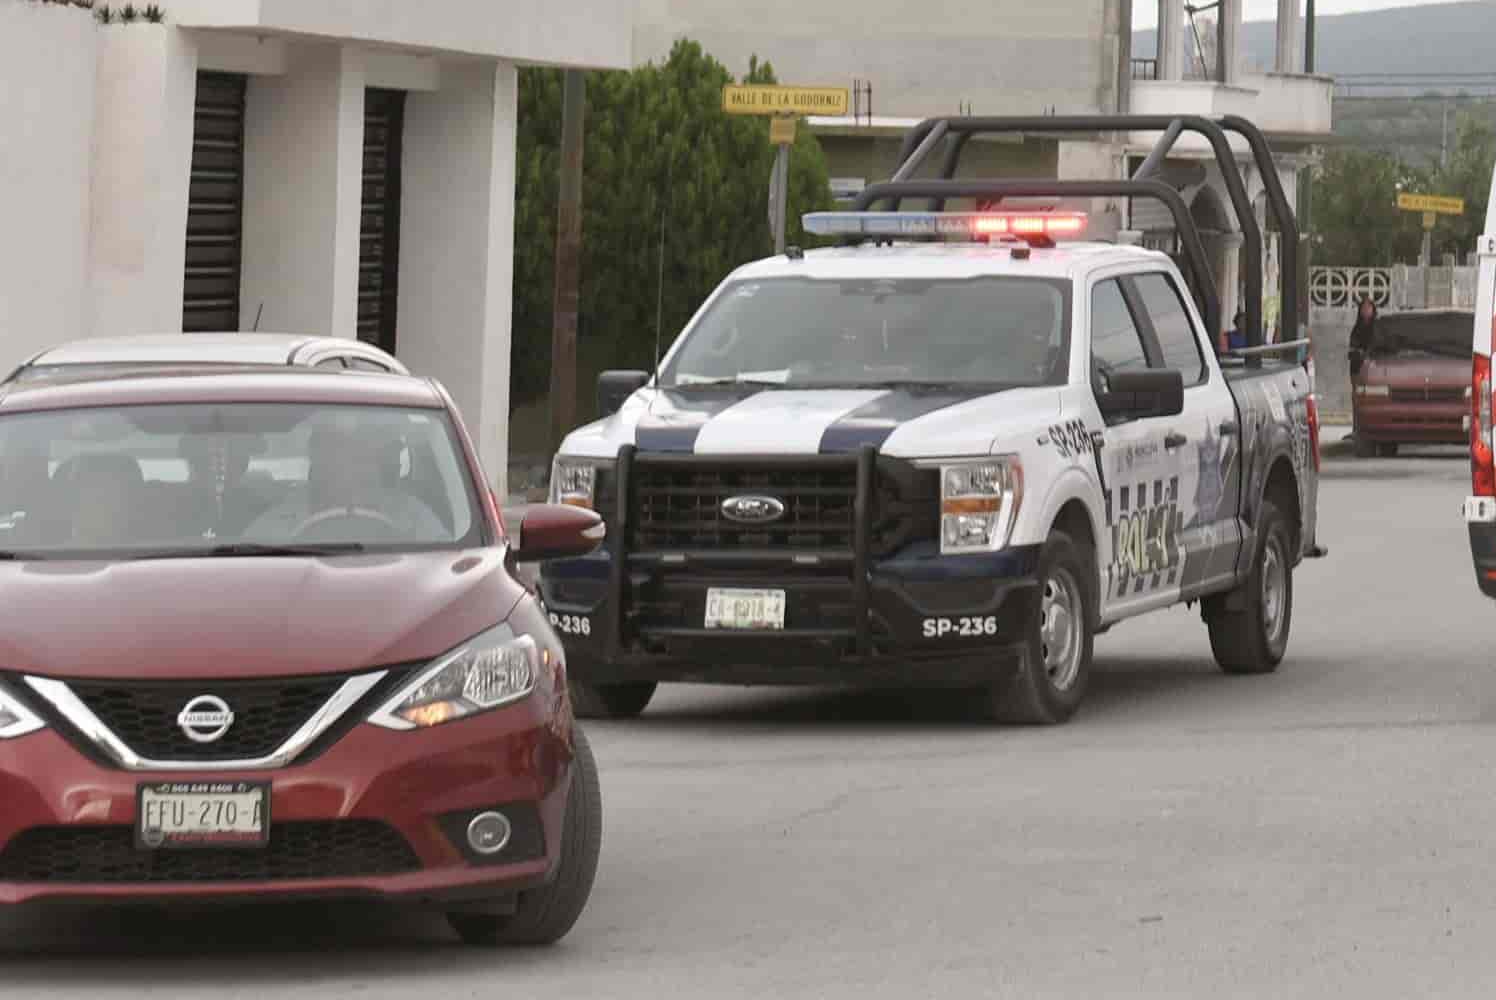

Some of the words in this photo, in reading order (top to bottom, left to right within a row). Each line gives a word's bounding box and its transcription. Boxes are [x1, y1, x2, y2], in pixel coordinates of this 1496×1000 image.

[761, 91, 773, 105] DE
[549, 612, 591, 636] P-236
[922, 615, 998, 638] SP-236
